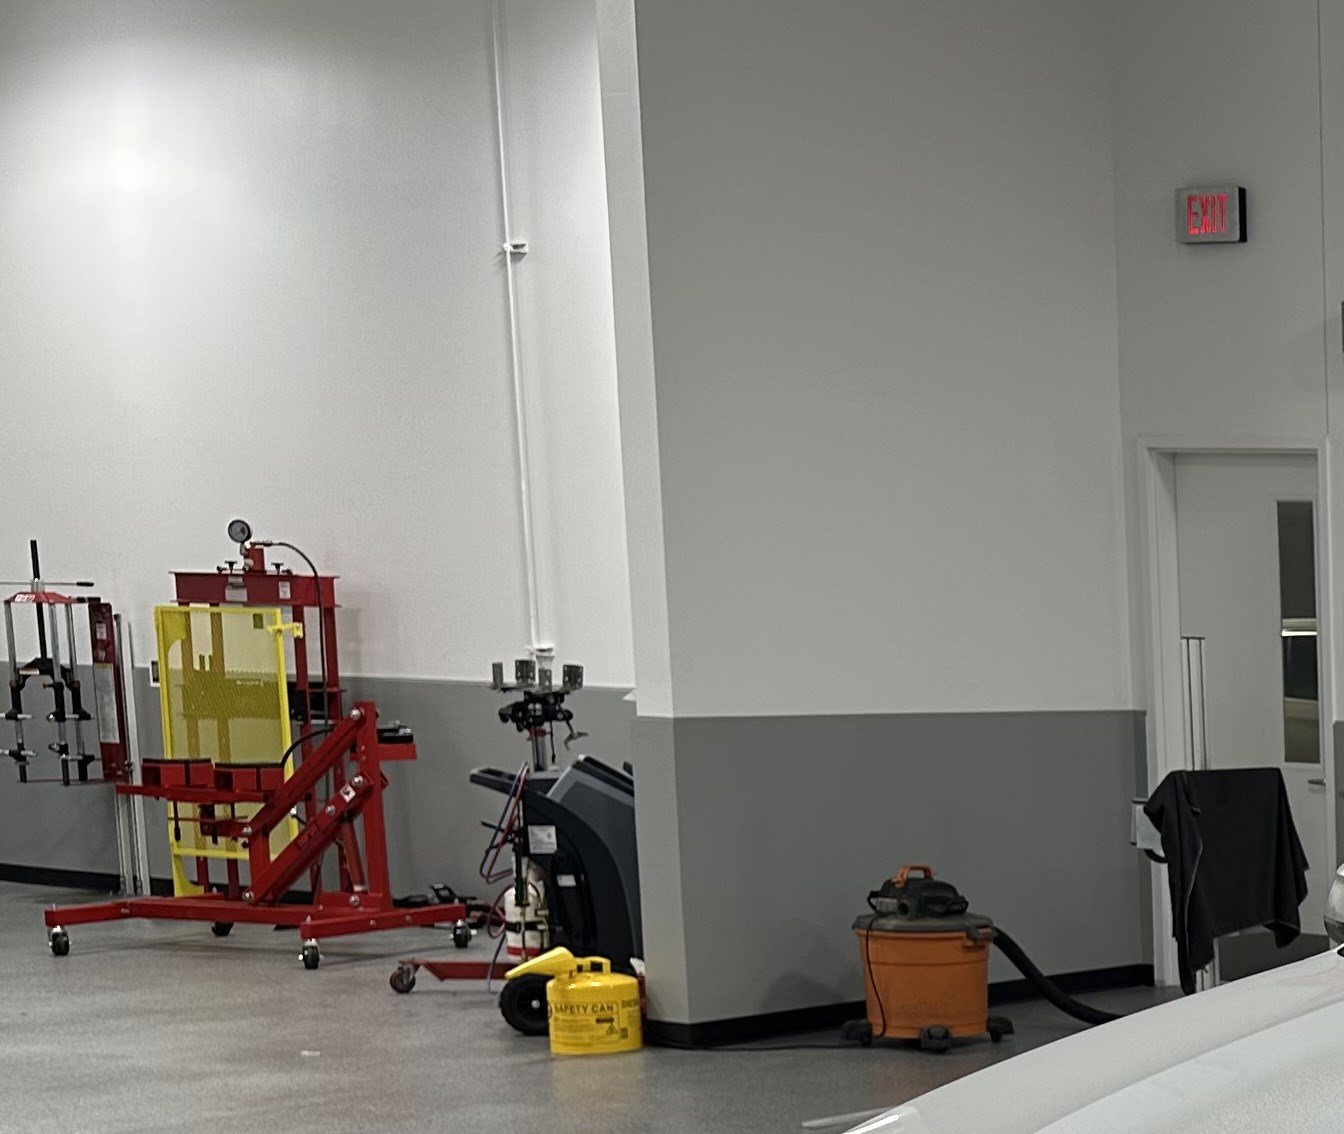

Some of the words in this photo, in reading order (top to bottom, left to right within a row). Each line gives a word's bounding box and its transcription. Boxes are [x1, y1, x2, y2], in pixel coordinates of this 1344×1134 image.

[1187, 193, 1227, 235] EXIT
[554, 1004, 588, 1014] SAFETY
[591, 1004, 614, 1013] CAN
